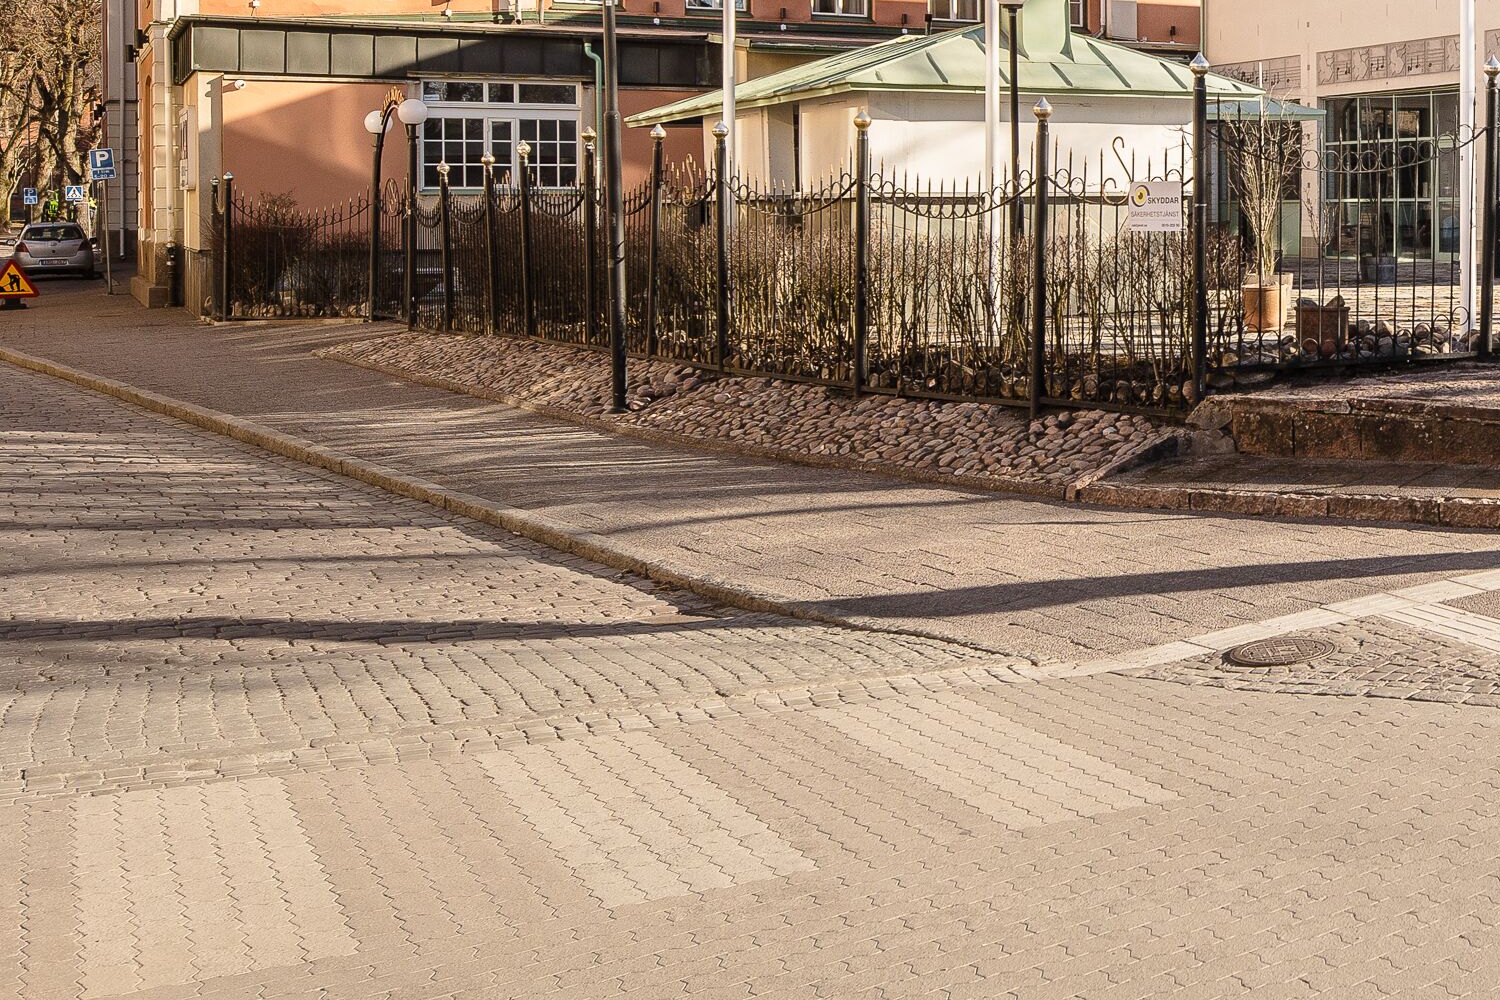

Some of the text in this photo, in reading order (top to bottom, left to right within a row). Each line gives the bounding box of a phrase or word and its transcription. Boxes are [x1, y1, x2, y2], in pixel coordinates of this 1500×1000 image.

[96, 151, 109, 168] P
[1147, 197, 1179, 205] SKYDDAR
[1131, 210, 1179, 218] SÄKERHETSTJÄNST
